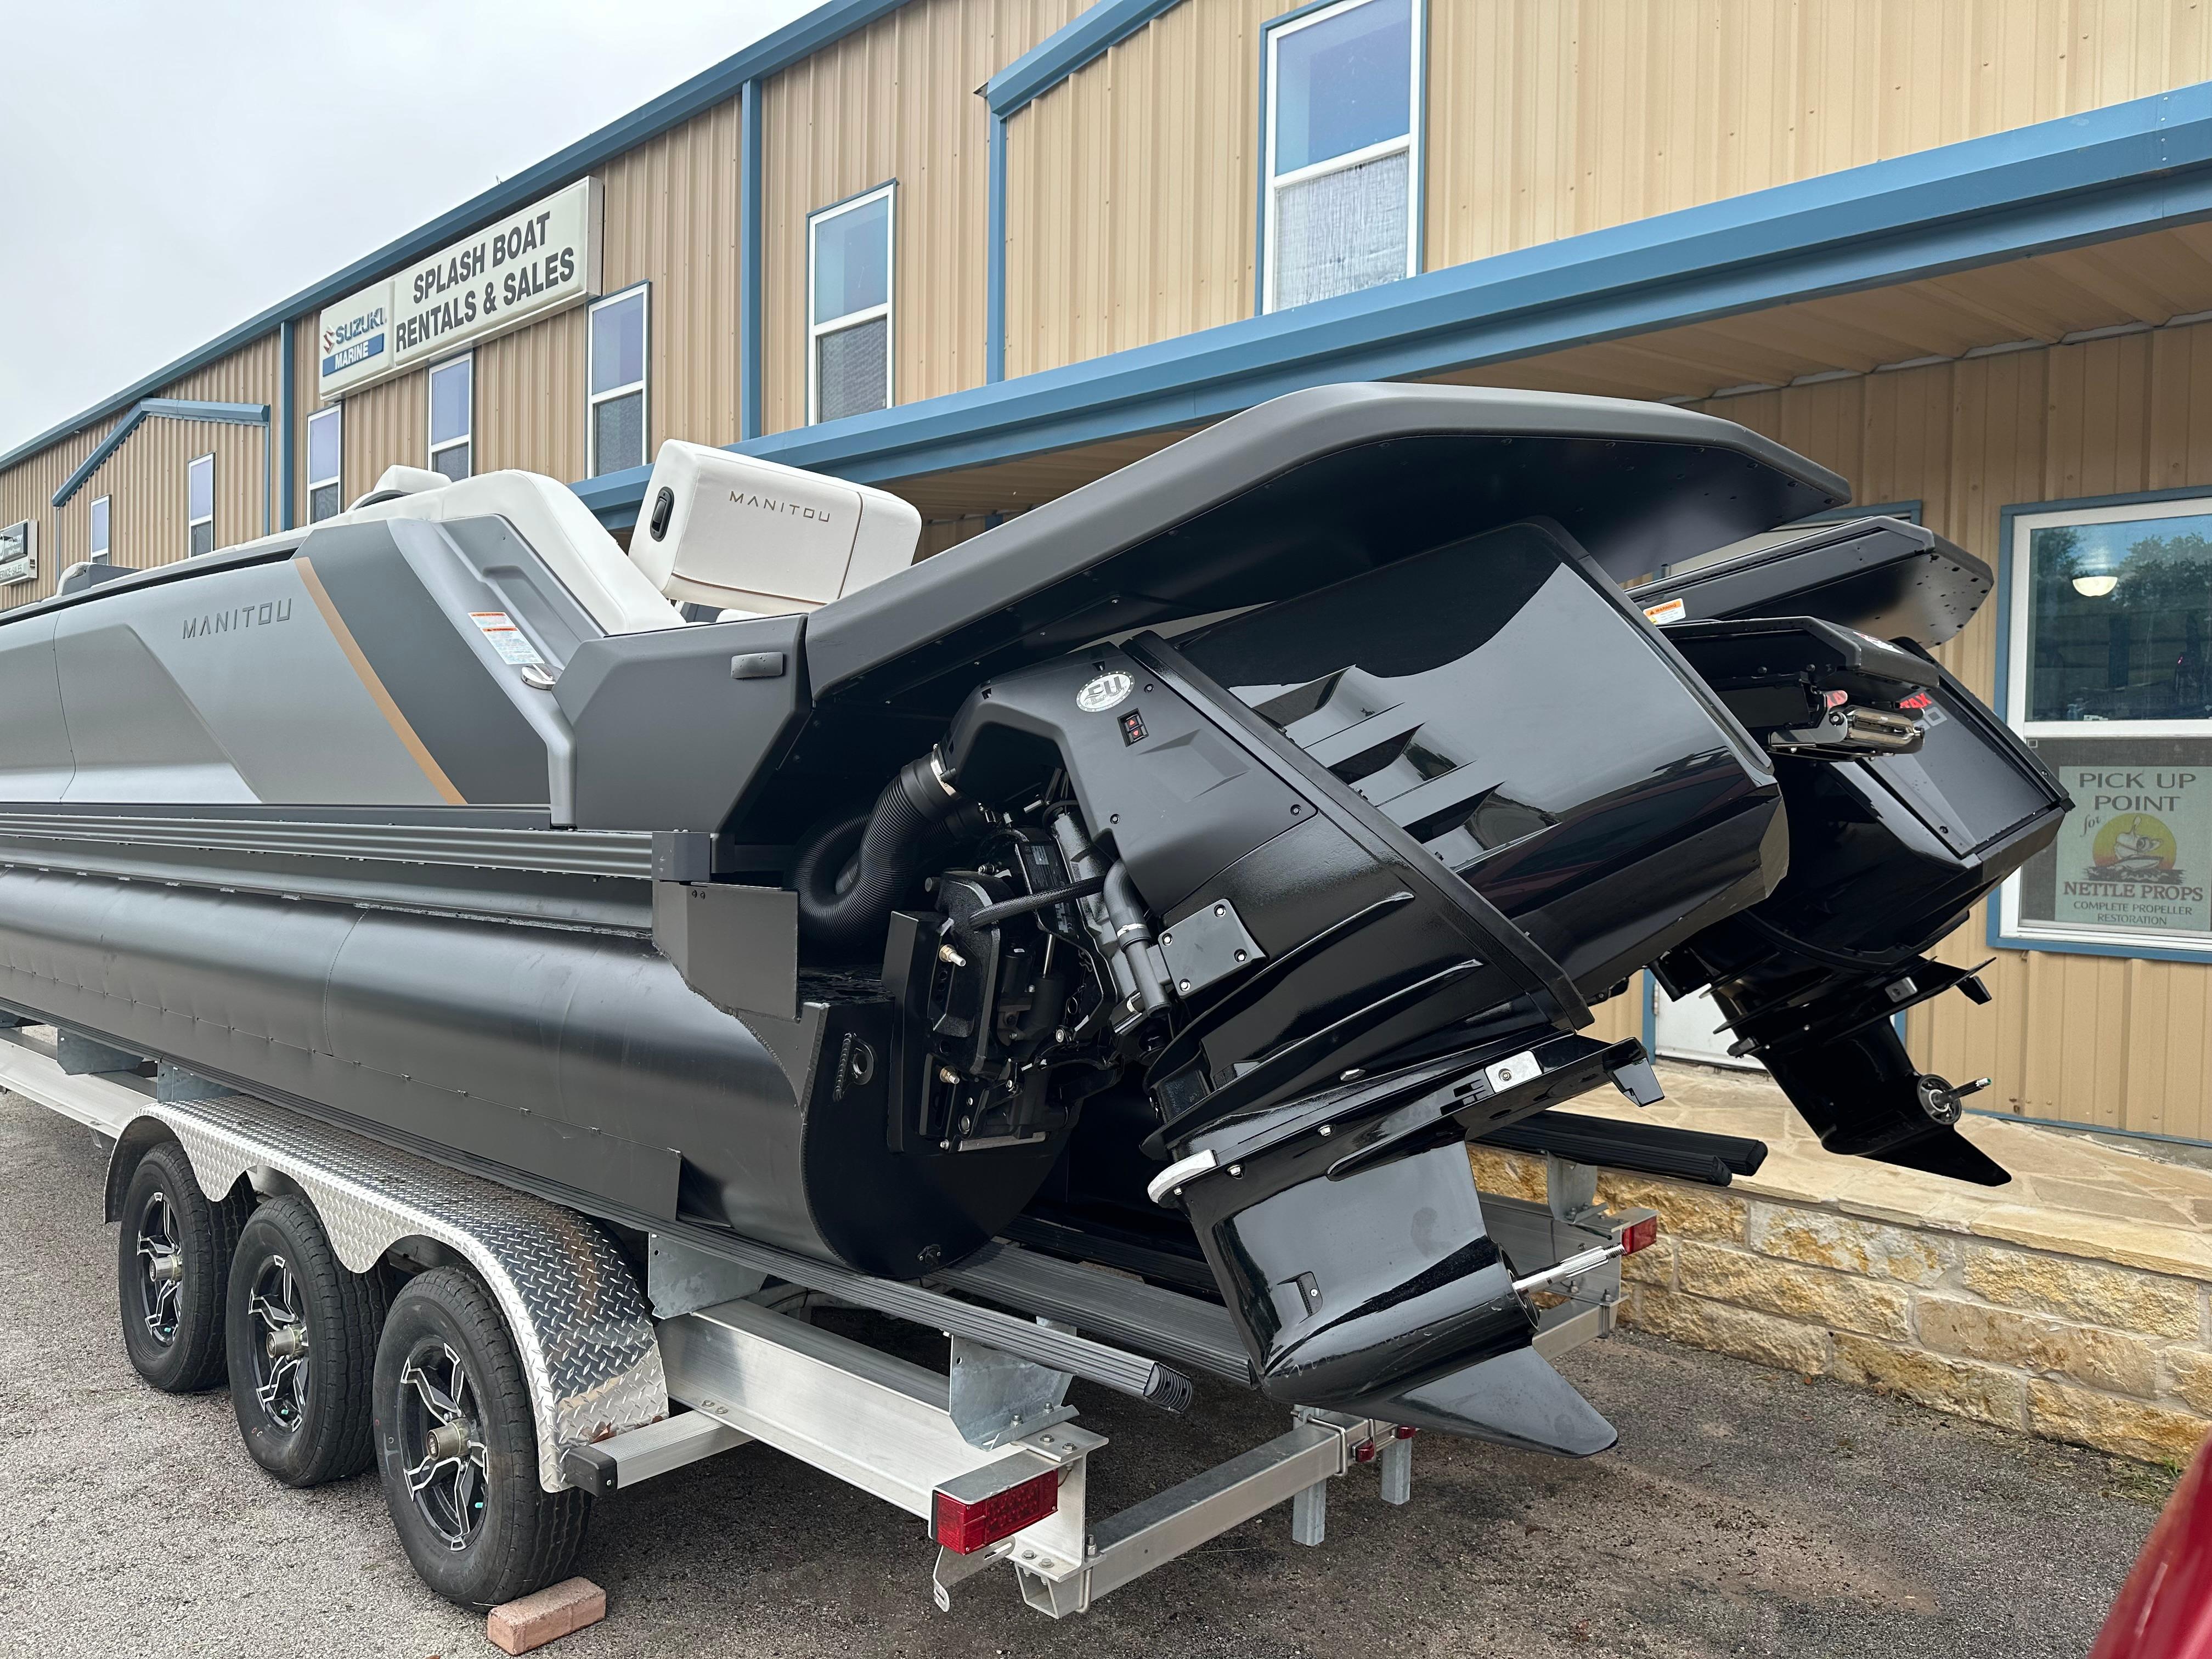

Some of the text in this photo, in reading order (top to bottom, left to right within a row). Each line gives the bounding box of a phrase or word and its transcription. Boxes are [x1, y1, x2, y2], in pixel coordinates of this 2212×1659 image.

[413, 211, 550, 304] SPLASH BOAT
[396, 247, 574, 353] RENTALS & SALES
[336, 307, 384, 345] SUZUKI
[335, 341, 369, 370] MARINE
[729, 490, 831, 522] MANITOU
[183, 598, 292, 639] MANITOU
[2079, 772, 2197, 789] PICK UP
[2094, 795, 2181, 811] POINT
[2080, 814, 2102, 838] for
[2063, 881, 2204, 901] NETTLE PROPS
[2074, 901, 2193, 915] COMPLETE PROPELLER
[2097, 913, 2167, 926] RESTORATION
